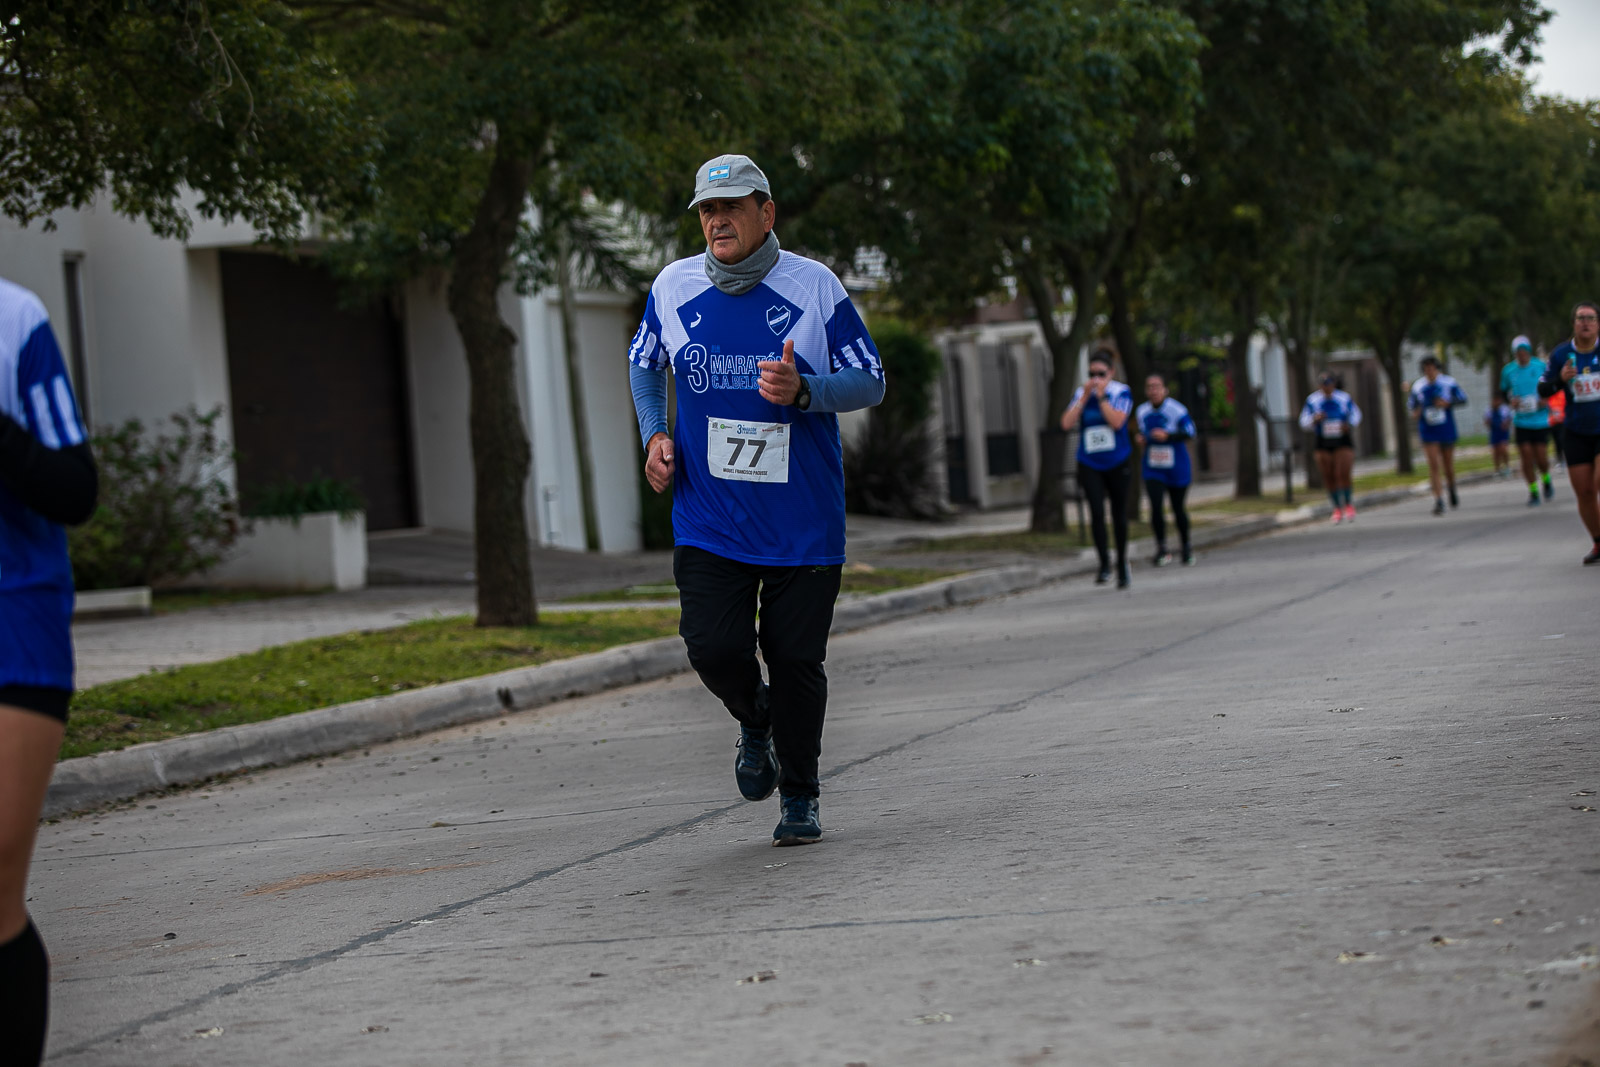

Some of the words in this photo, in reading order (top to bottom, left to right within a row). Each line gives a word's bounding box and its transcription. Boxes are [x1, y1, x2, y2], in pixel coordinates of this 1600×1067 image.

[684, 343, 709, 393] 3
[710, 352, 782, 375] MARAT
[726, 437, 767, 468] 77
